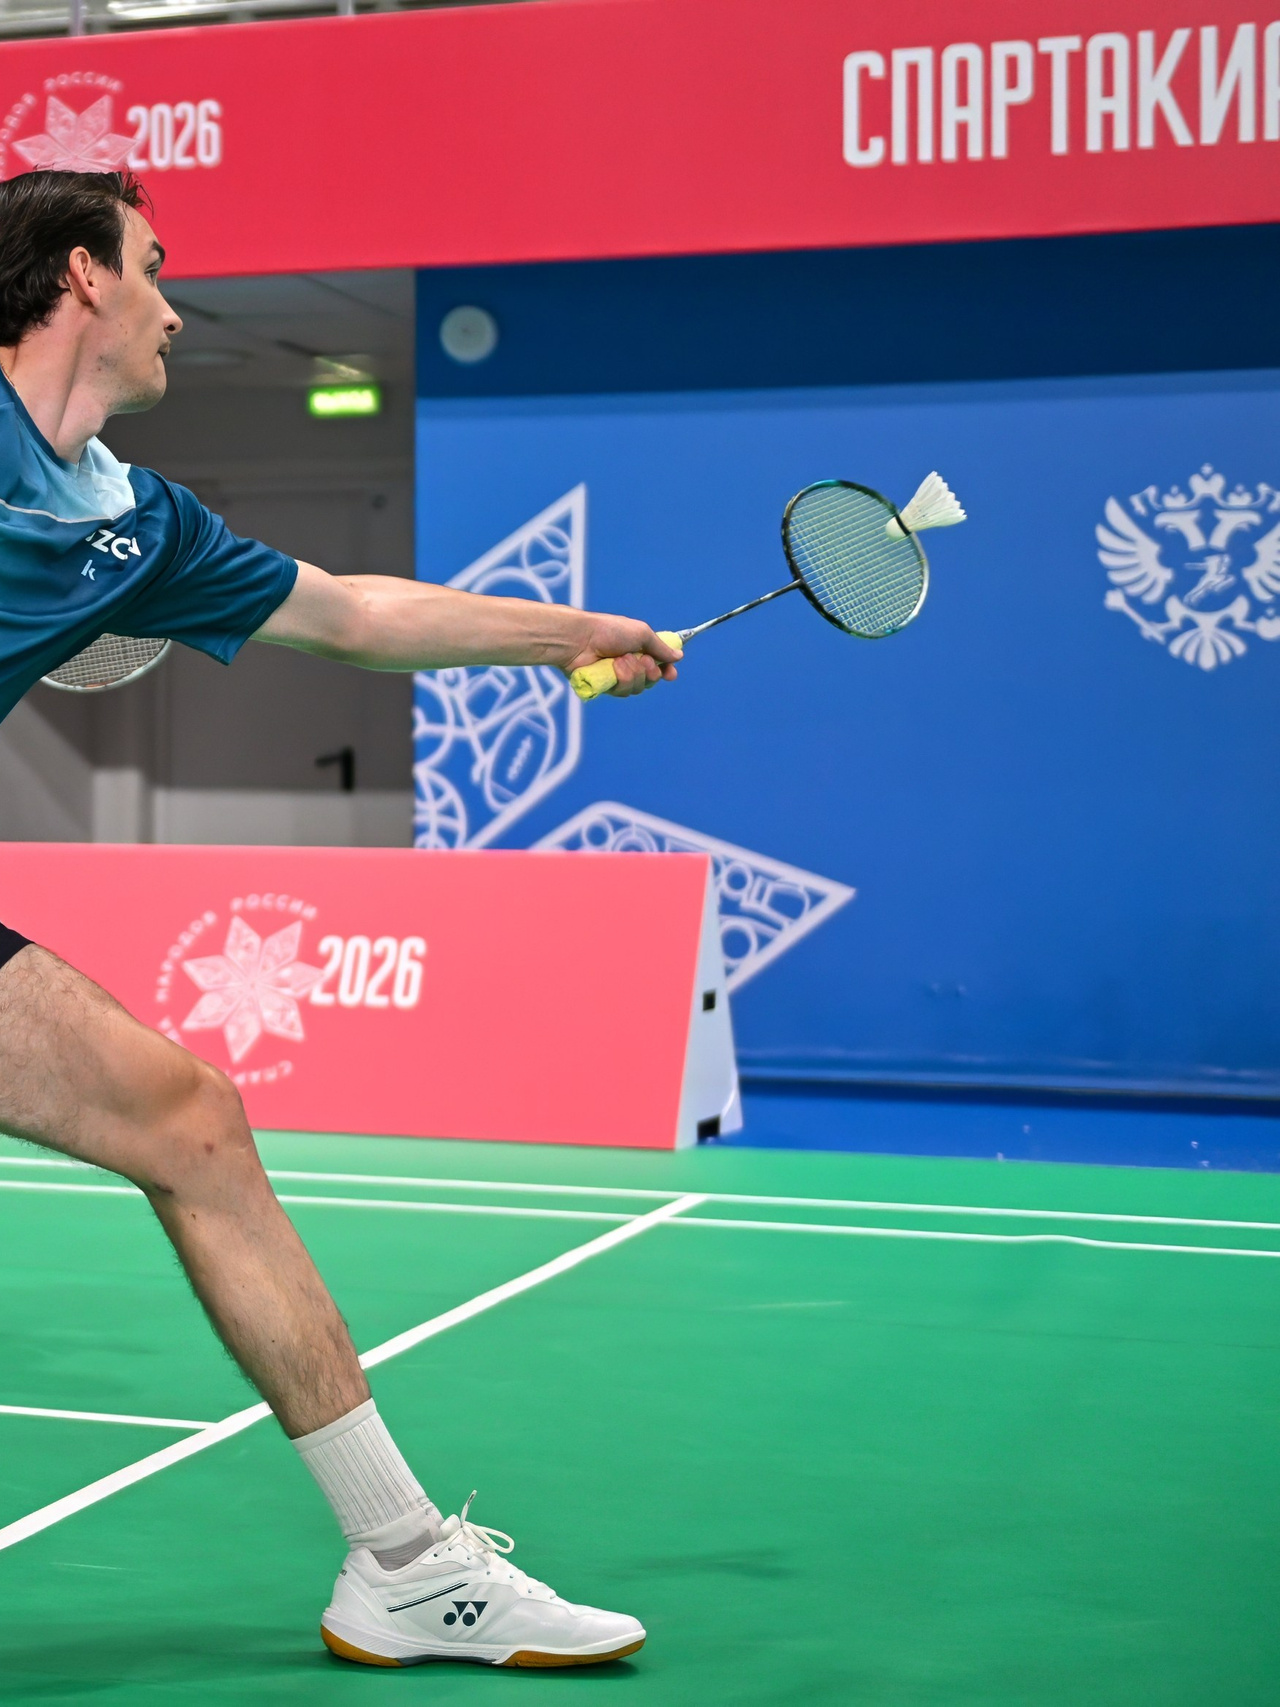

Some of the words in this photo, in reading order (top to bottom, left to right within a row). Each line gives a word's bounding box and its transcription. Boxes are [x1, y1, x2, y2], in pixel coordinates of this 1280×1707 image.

[126, 99, 223, 170] 2026
[230, 893, 318, 920] РОССИИ
[310, 935, 427, 1008] 2026
